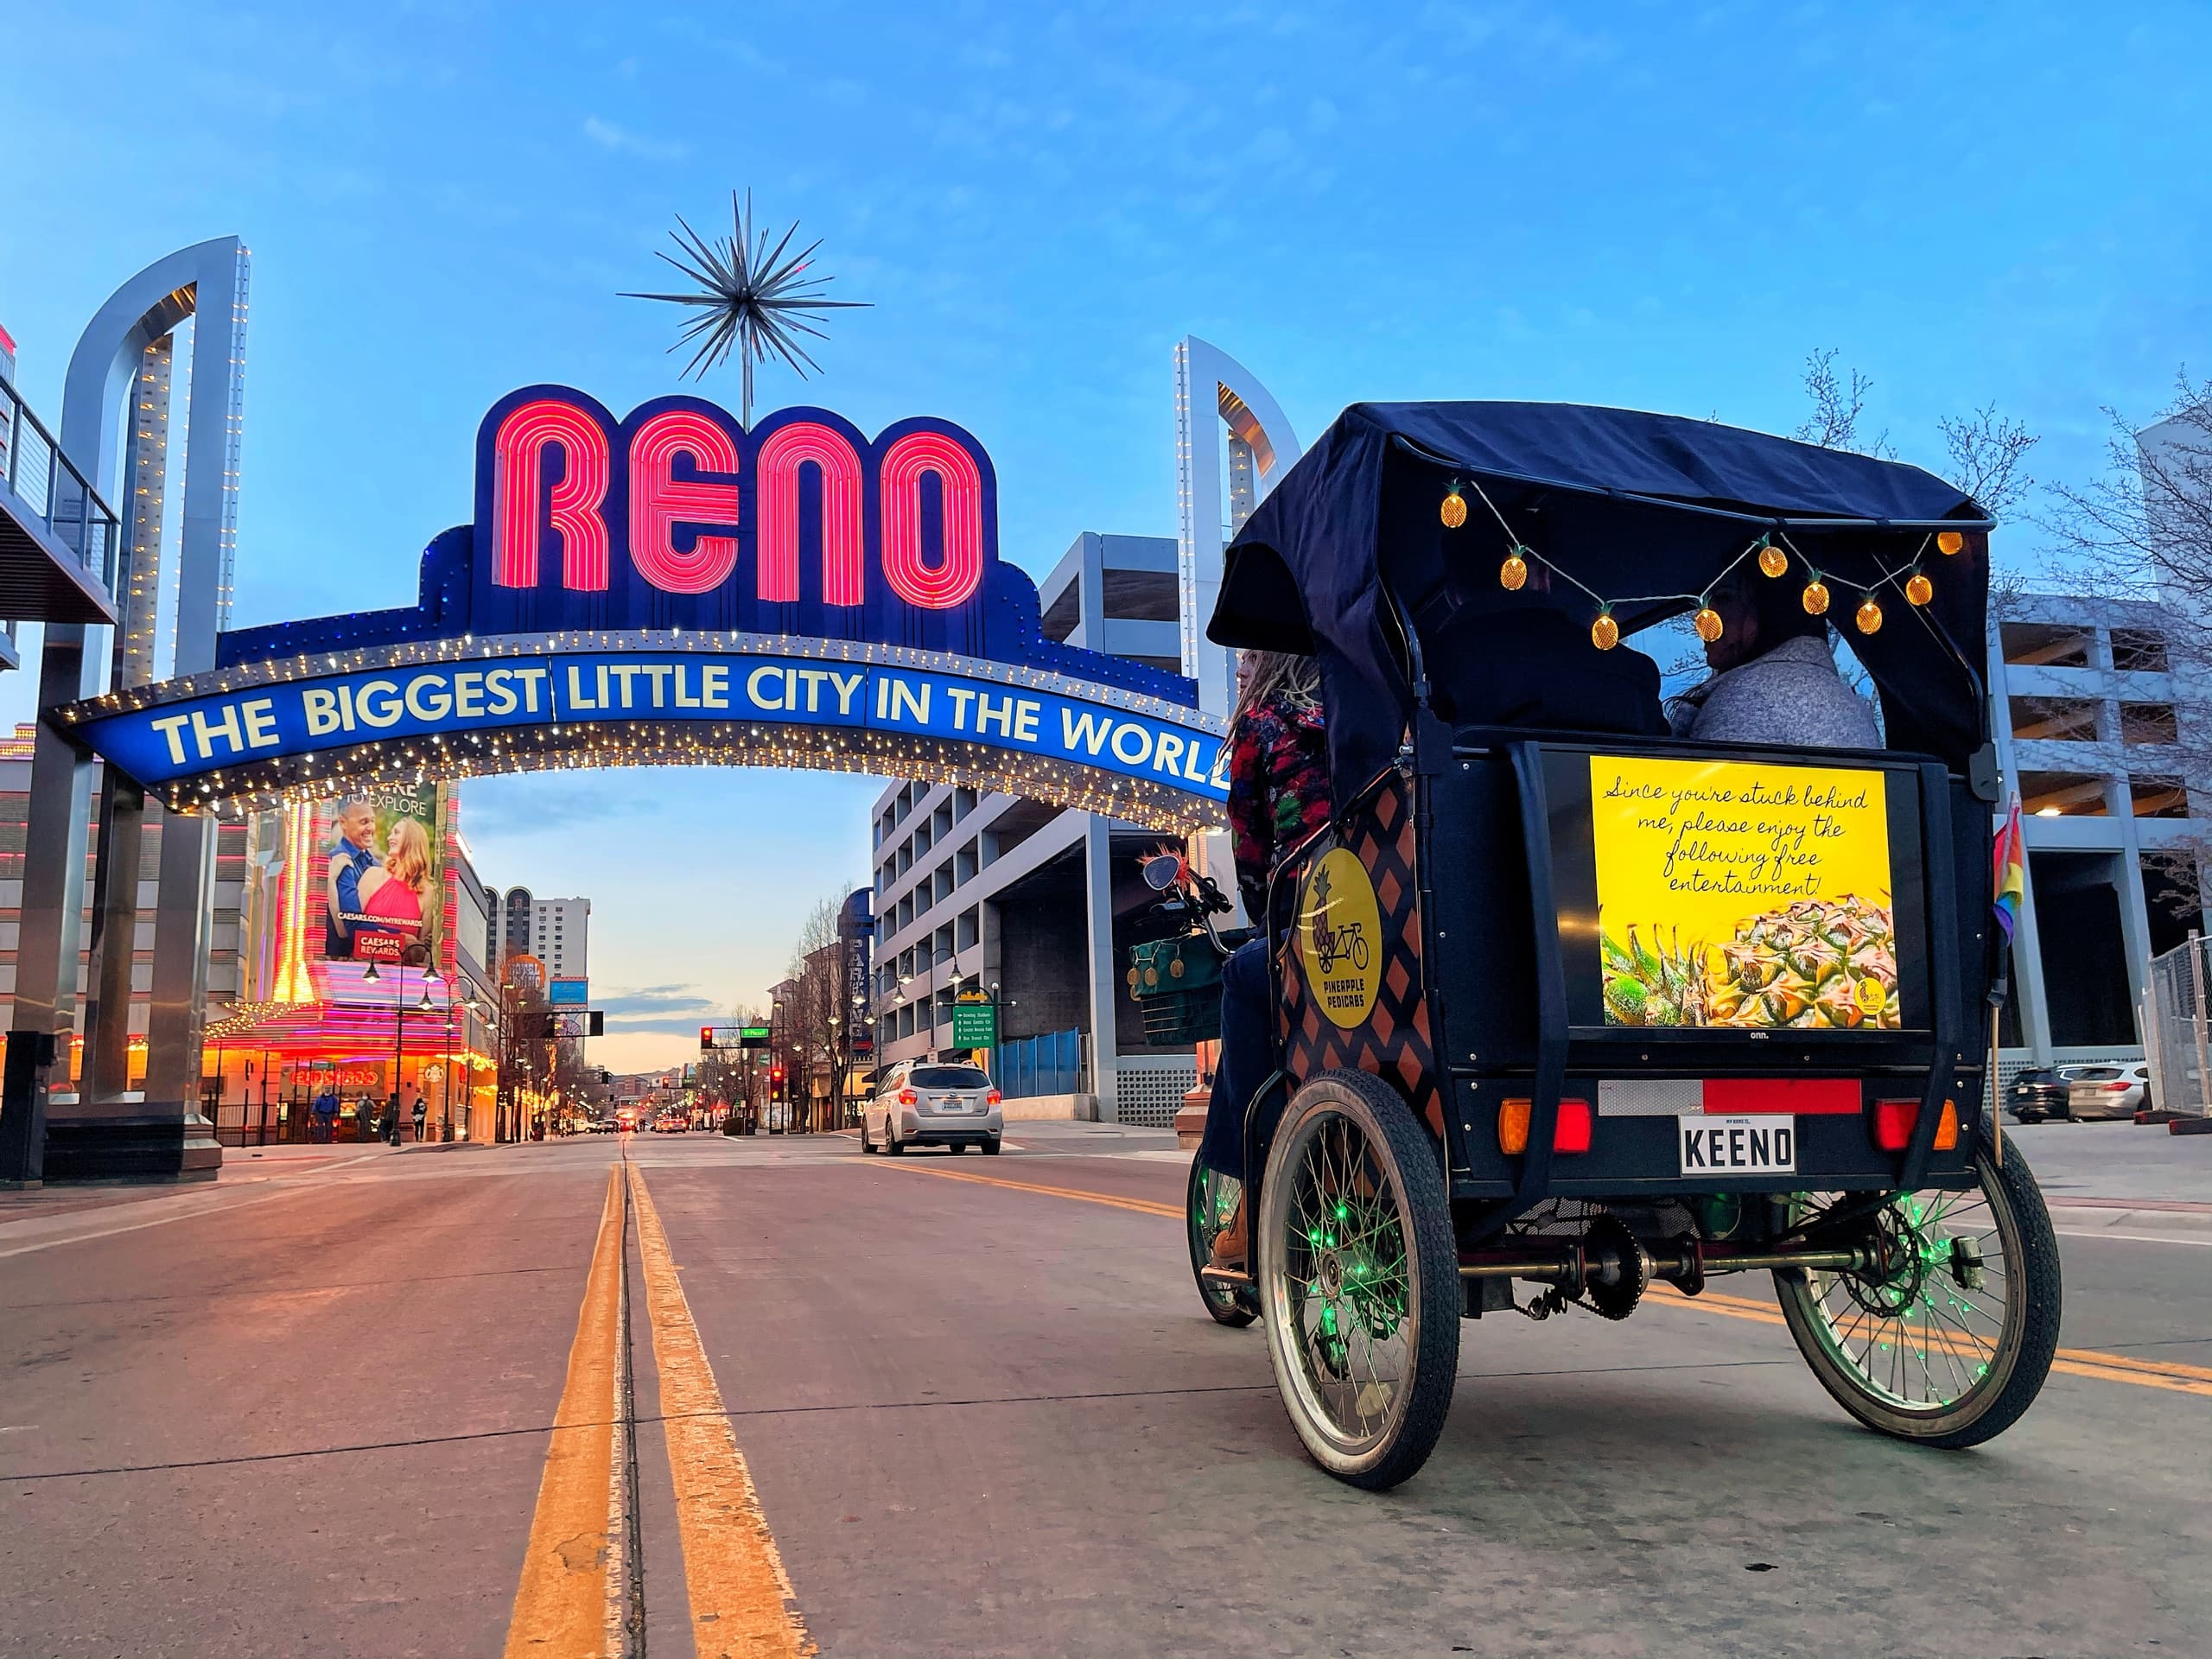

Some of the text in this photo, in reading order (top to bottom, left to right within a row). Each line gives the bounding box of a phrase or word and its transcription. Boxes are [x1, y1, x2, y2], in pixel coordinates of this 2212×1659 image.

[492, 400, 983, 609] RENO
[151, 698, 280, 766] THE
[302, 668, 547, 736] BIGGEST
[568, 665, 728, 711] LITTLE
[747, 667, 863, 715] CITY
[876, 678, 931, 724] IN
[947, 688, 1040, 742] THE
[368, 794, 427, 817] EXPLORE
[1602, 776, 1868, 816] Since you're stuck behind
[1638, 811, 1847, 852] me, please enjoy the
[1663, 840, 1822, 881] following free
[1669, 868, 1821, 896] entertainment!
[338, 912, 423, 927] CAESARS.COM/MYREWARDS
[360, 937, 400, 948] CAESARS
[360, 946, 400, 957] REWARDS
[1324, 978, 1365, 994] PINEAPPLE
[1327, 994, 1365, 1008] PEDICABS
[1684, 1128, 1792, 1168] KEENO
